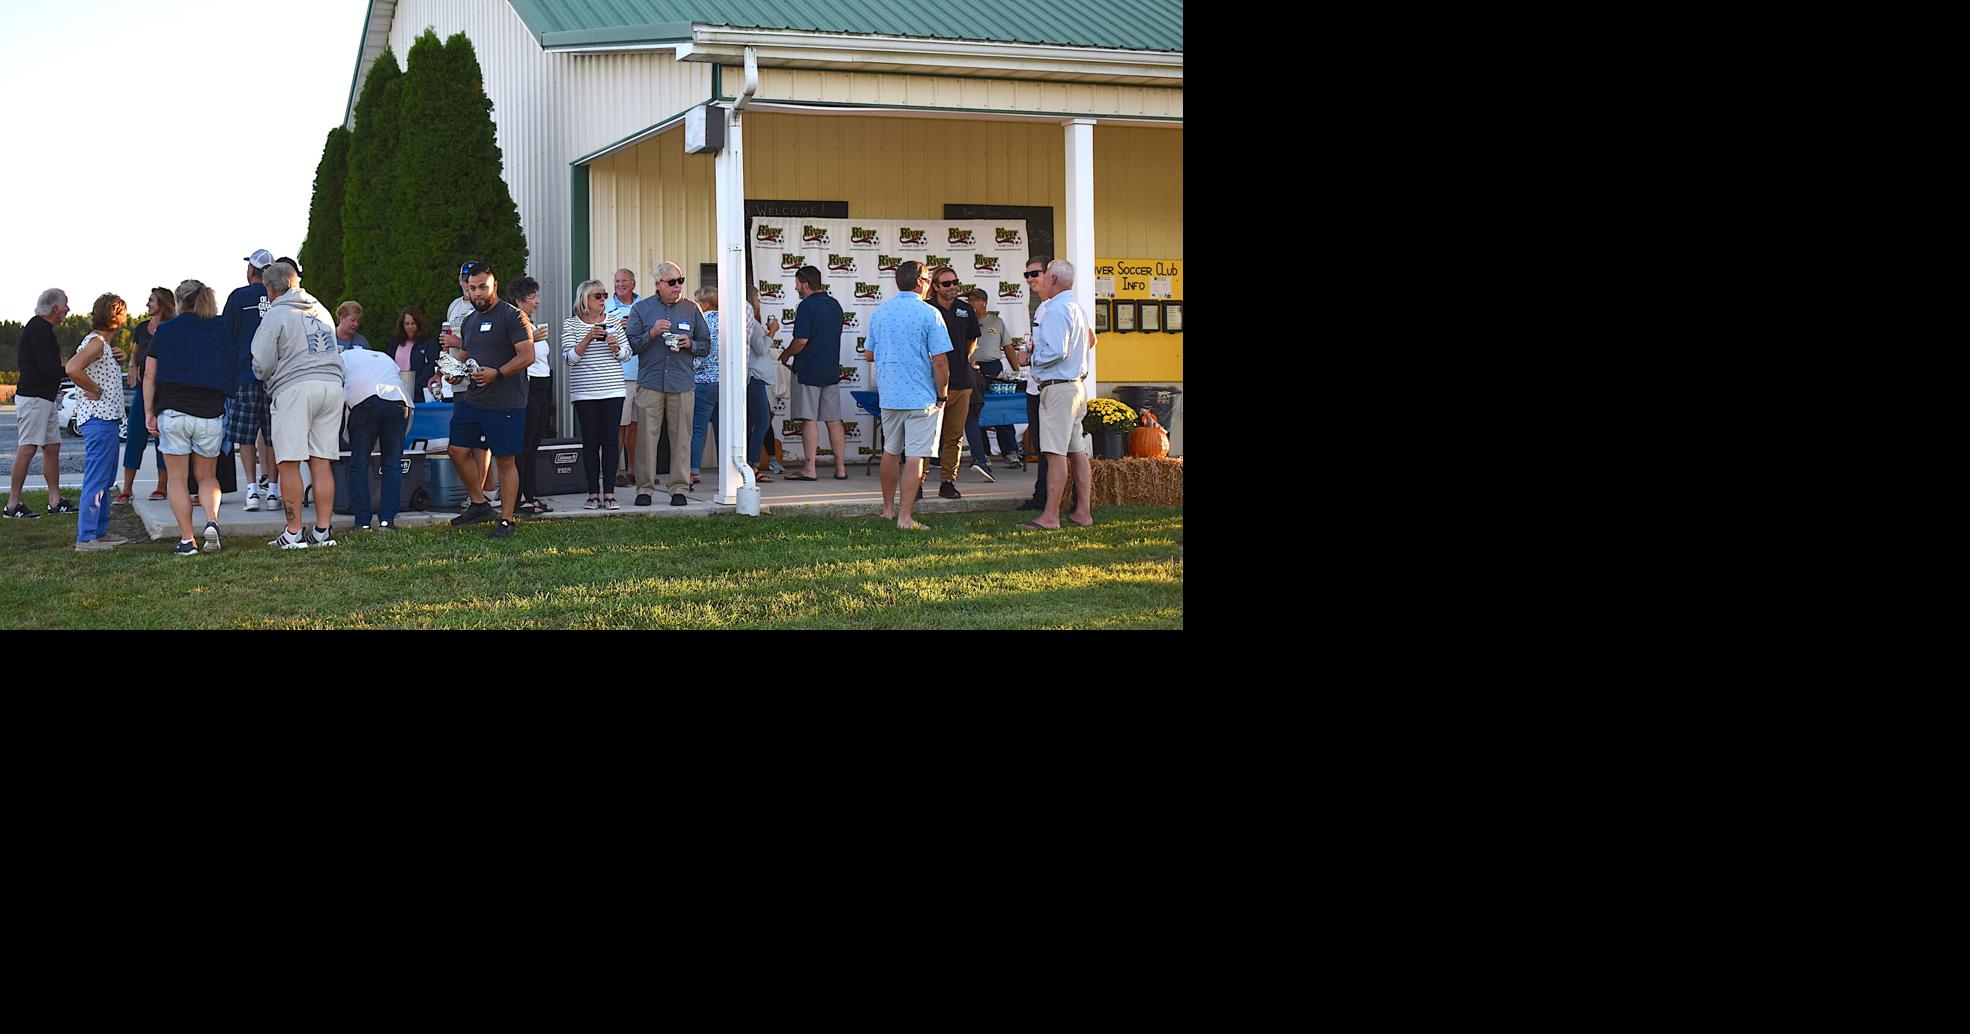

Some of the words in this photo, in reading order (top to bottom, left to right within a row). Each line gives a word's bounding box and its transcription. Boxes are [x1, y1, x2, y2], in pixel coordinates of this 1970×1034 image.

[758, 224, 783, 236] River
[803, 225, 827, 237] River
[851, 227, 877, 239] River
[900, 227, 925, 239] River
[948, 227, 973, 239] River
[995, 227, 1019, 239] River
[782, 253, 806, 265] River
[828, 254, 854, 266] River
[878, 255, 902, 267] River
[926, 254, 951, 267] River
[974, 254, 999, 266] River
[1095, 266, 1114, 275] IVER
[1118, 261, 1152, 275] SOCCER
[759, 280, 783, 292] River
[855, 282, 880, 294] River
[956, 282, 977, 293] iver
[999, 281, 1020, 293] River
[1122, 277, 1145, 290] INFO
